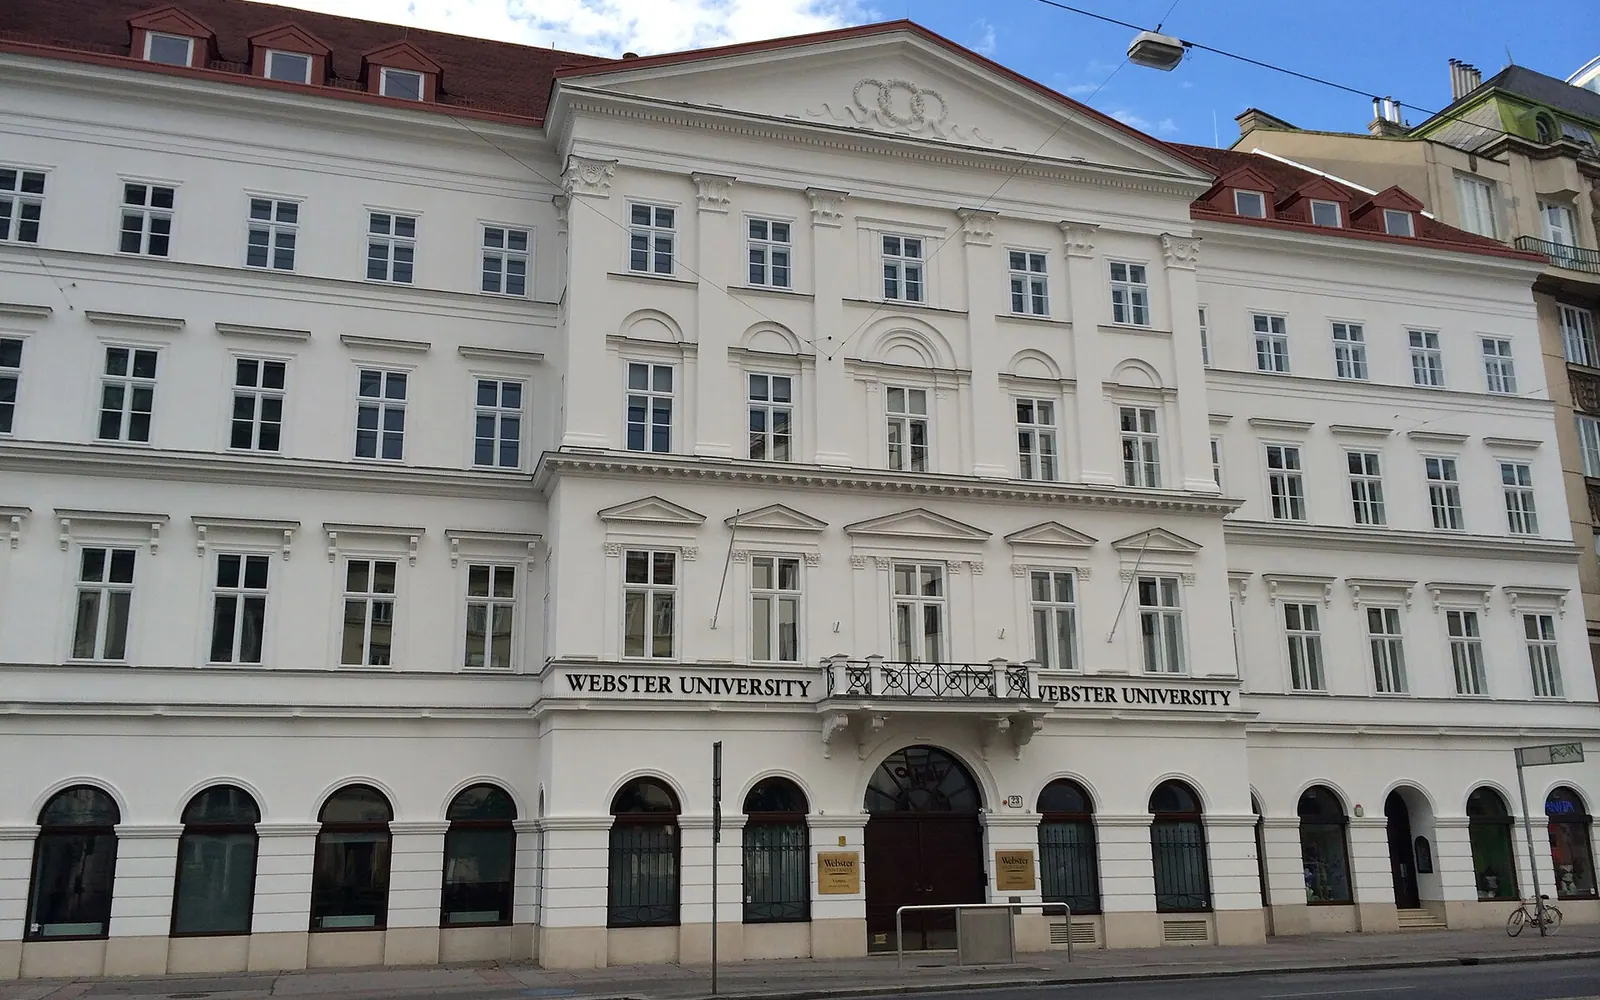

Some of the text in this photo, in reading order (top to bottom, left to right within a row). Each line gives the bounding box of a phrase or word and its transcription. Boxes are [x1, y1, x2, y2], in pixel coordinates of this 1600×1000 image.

[565, 673, 812, 697] WEBSTER UNIVERSITY
[1123, 687, 1232, 706] UNIVERSITY
[823, 858, 854, 867] Webster
[1001, 856, 1029, 865] Webster
